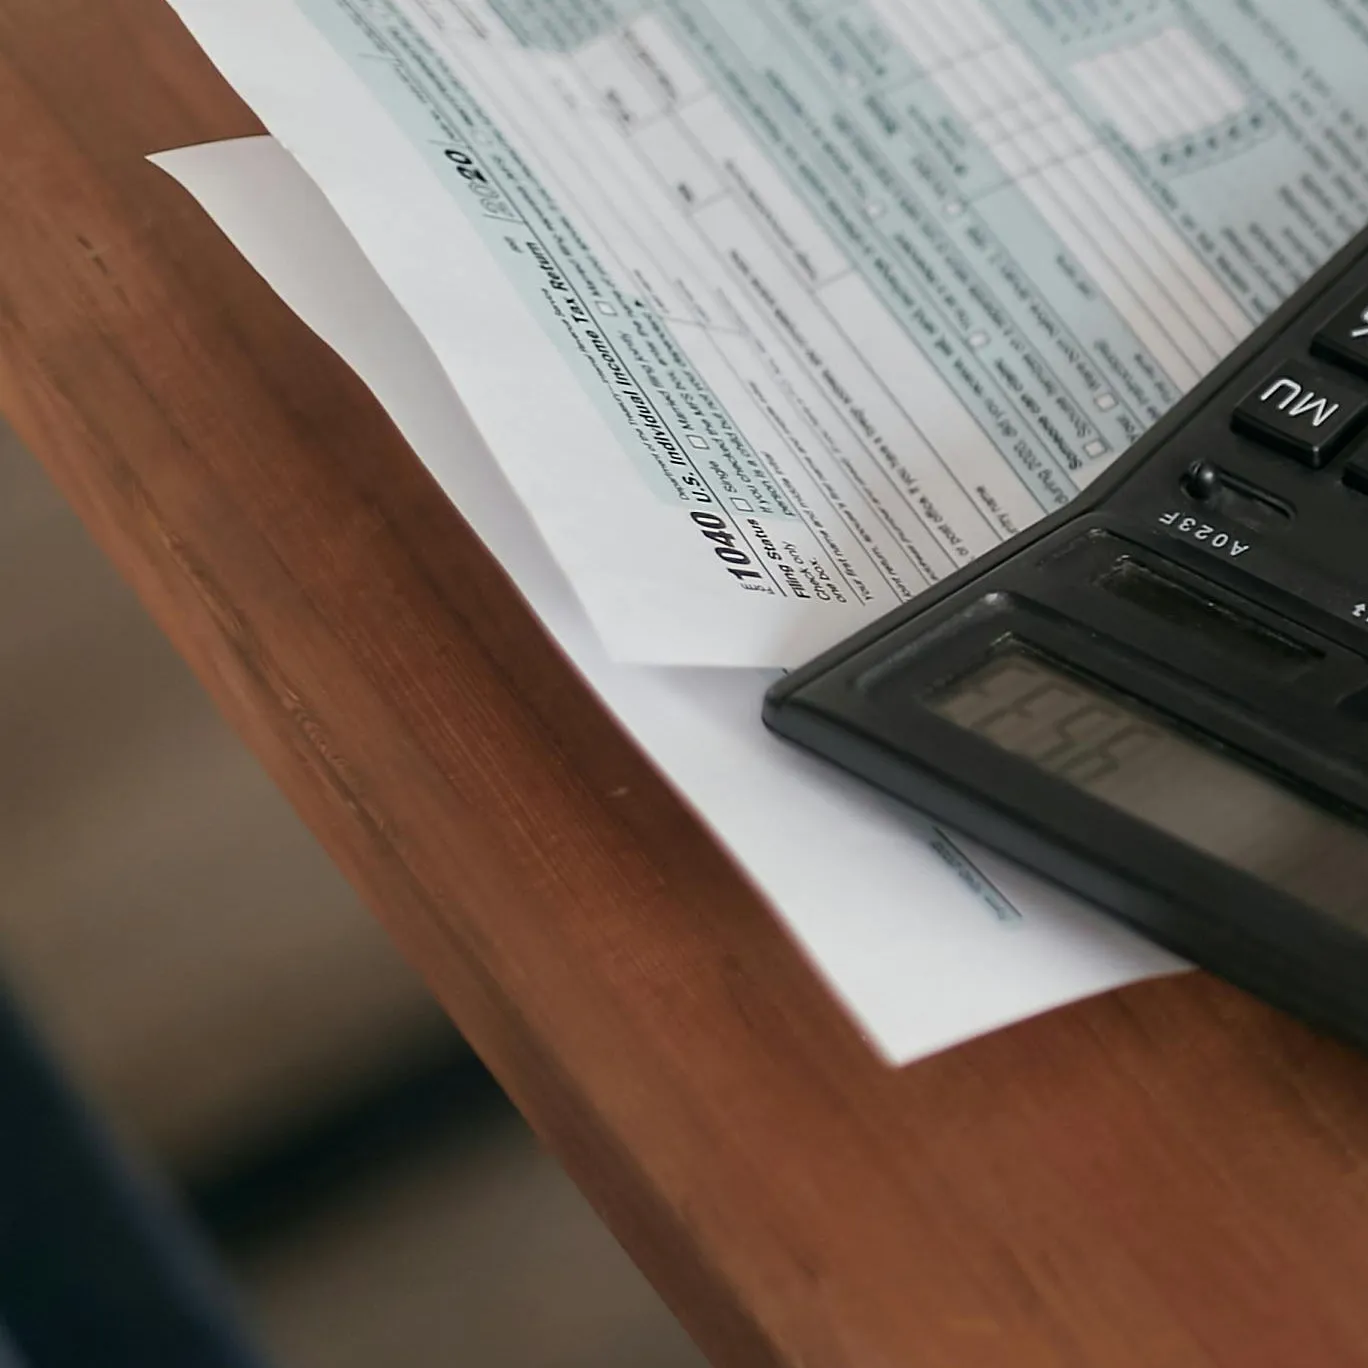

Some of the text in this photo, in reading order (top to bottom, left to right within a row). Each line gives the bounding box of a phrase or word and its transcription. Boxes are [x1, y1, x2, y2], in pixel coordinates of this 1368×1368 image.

[443, 146, 513, 216] 2020
[525, 241, 569, 290] Return
[565, 298, 589, 322] Tax
[585, 329, 633, 384] Income
[1260, 378, 1339, 427] MU
[621, 390, 687, 464] Individual
[708, 460, 738, 492] Single
[711, 437, 752, 481] checked
[681, 471, 713, 502] U.S.
[746, 484, 770, 503] you
[761, 480, 796, 516] person
[690, 511, 776, 594] Form 1040
[819, 530, 844, 555] name
[1158, 510, 1249, 556] A023F
[746, 518, 812, 597] Filing Status
[782, 541, 832, 600] Check only
[809, 557, 848, 602] one box.
[837, 558, 857, 575] first
[852, 579, 874, 598] Your
